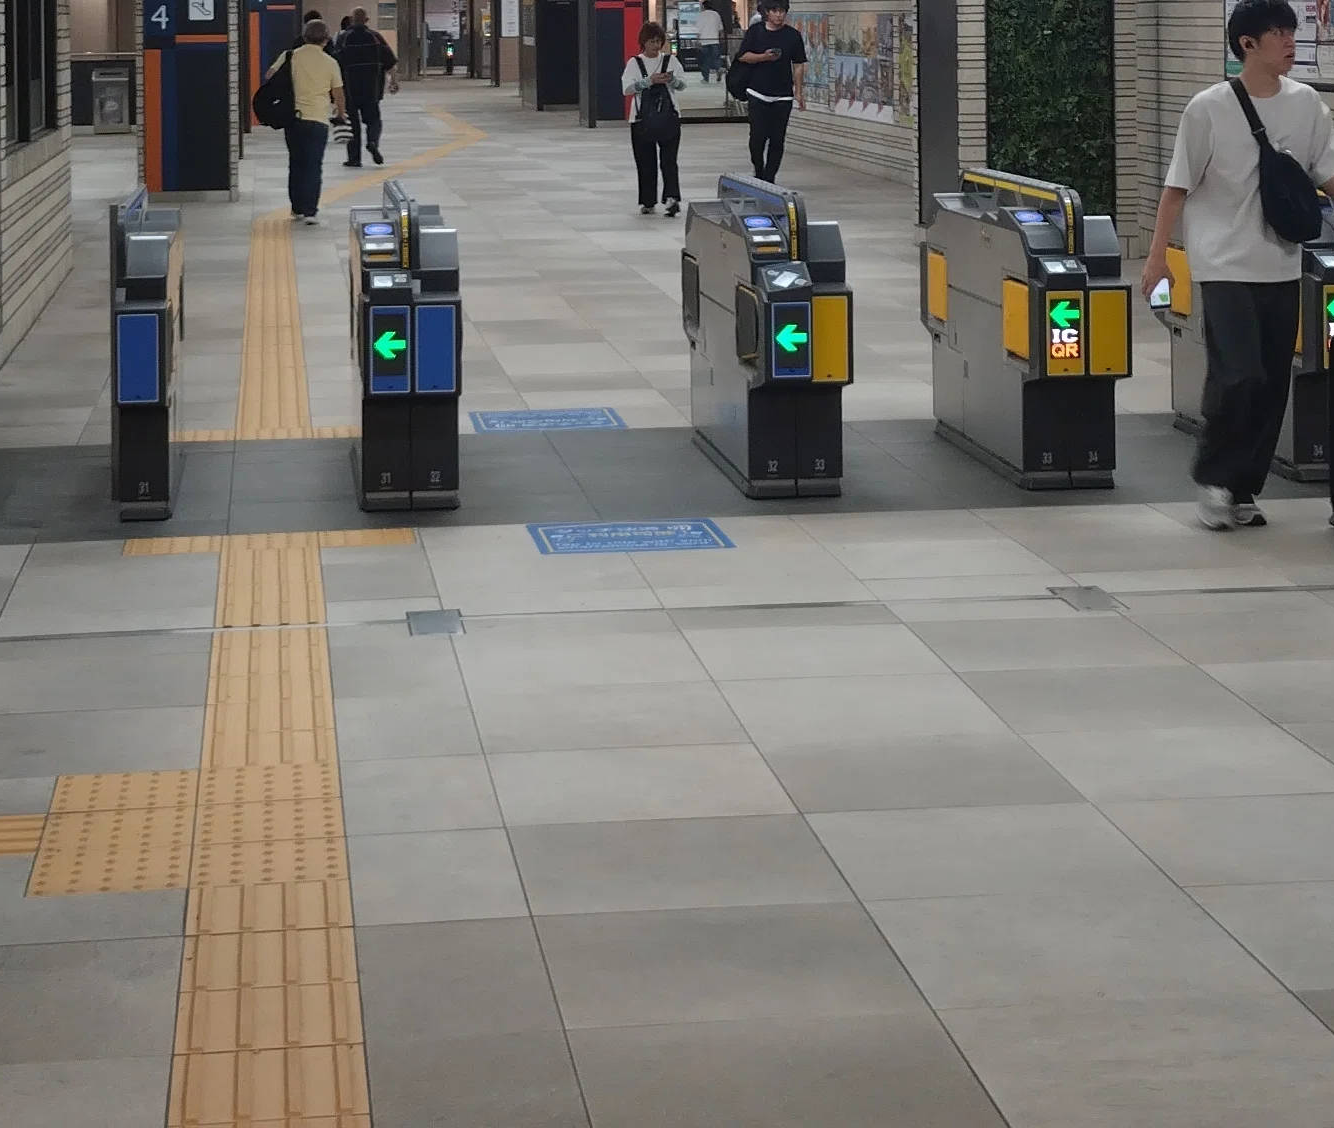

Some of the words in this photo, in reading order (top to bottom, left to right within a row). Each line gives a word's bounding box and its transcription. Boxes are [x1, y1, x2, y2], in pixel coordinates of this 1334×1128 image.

[151, 5, 169, 30] 4
[1051, 328, 1079, 343] IC
[1051, 344, 1079, 358] QR
